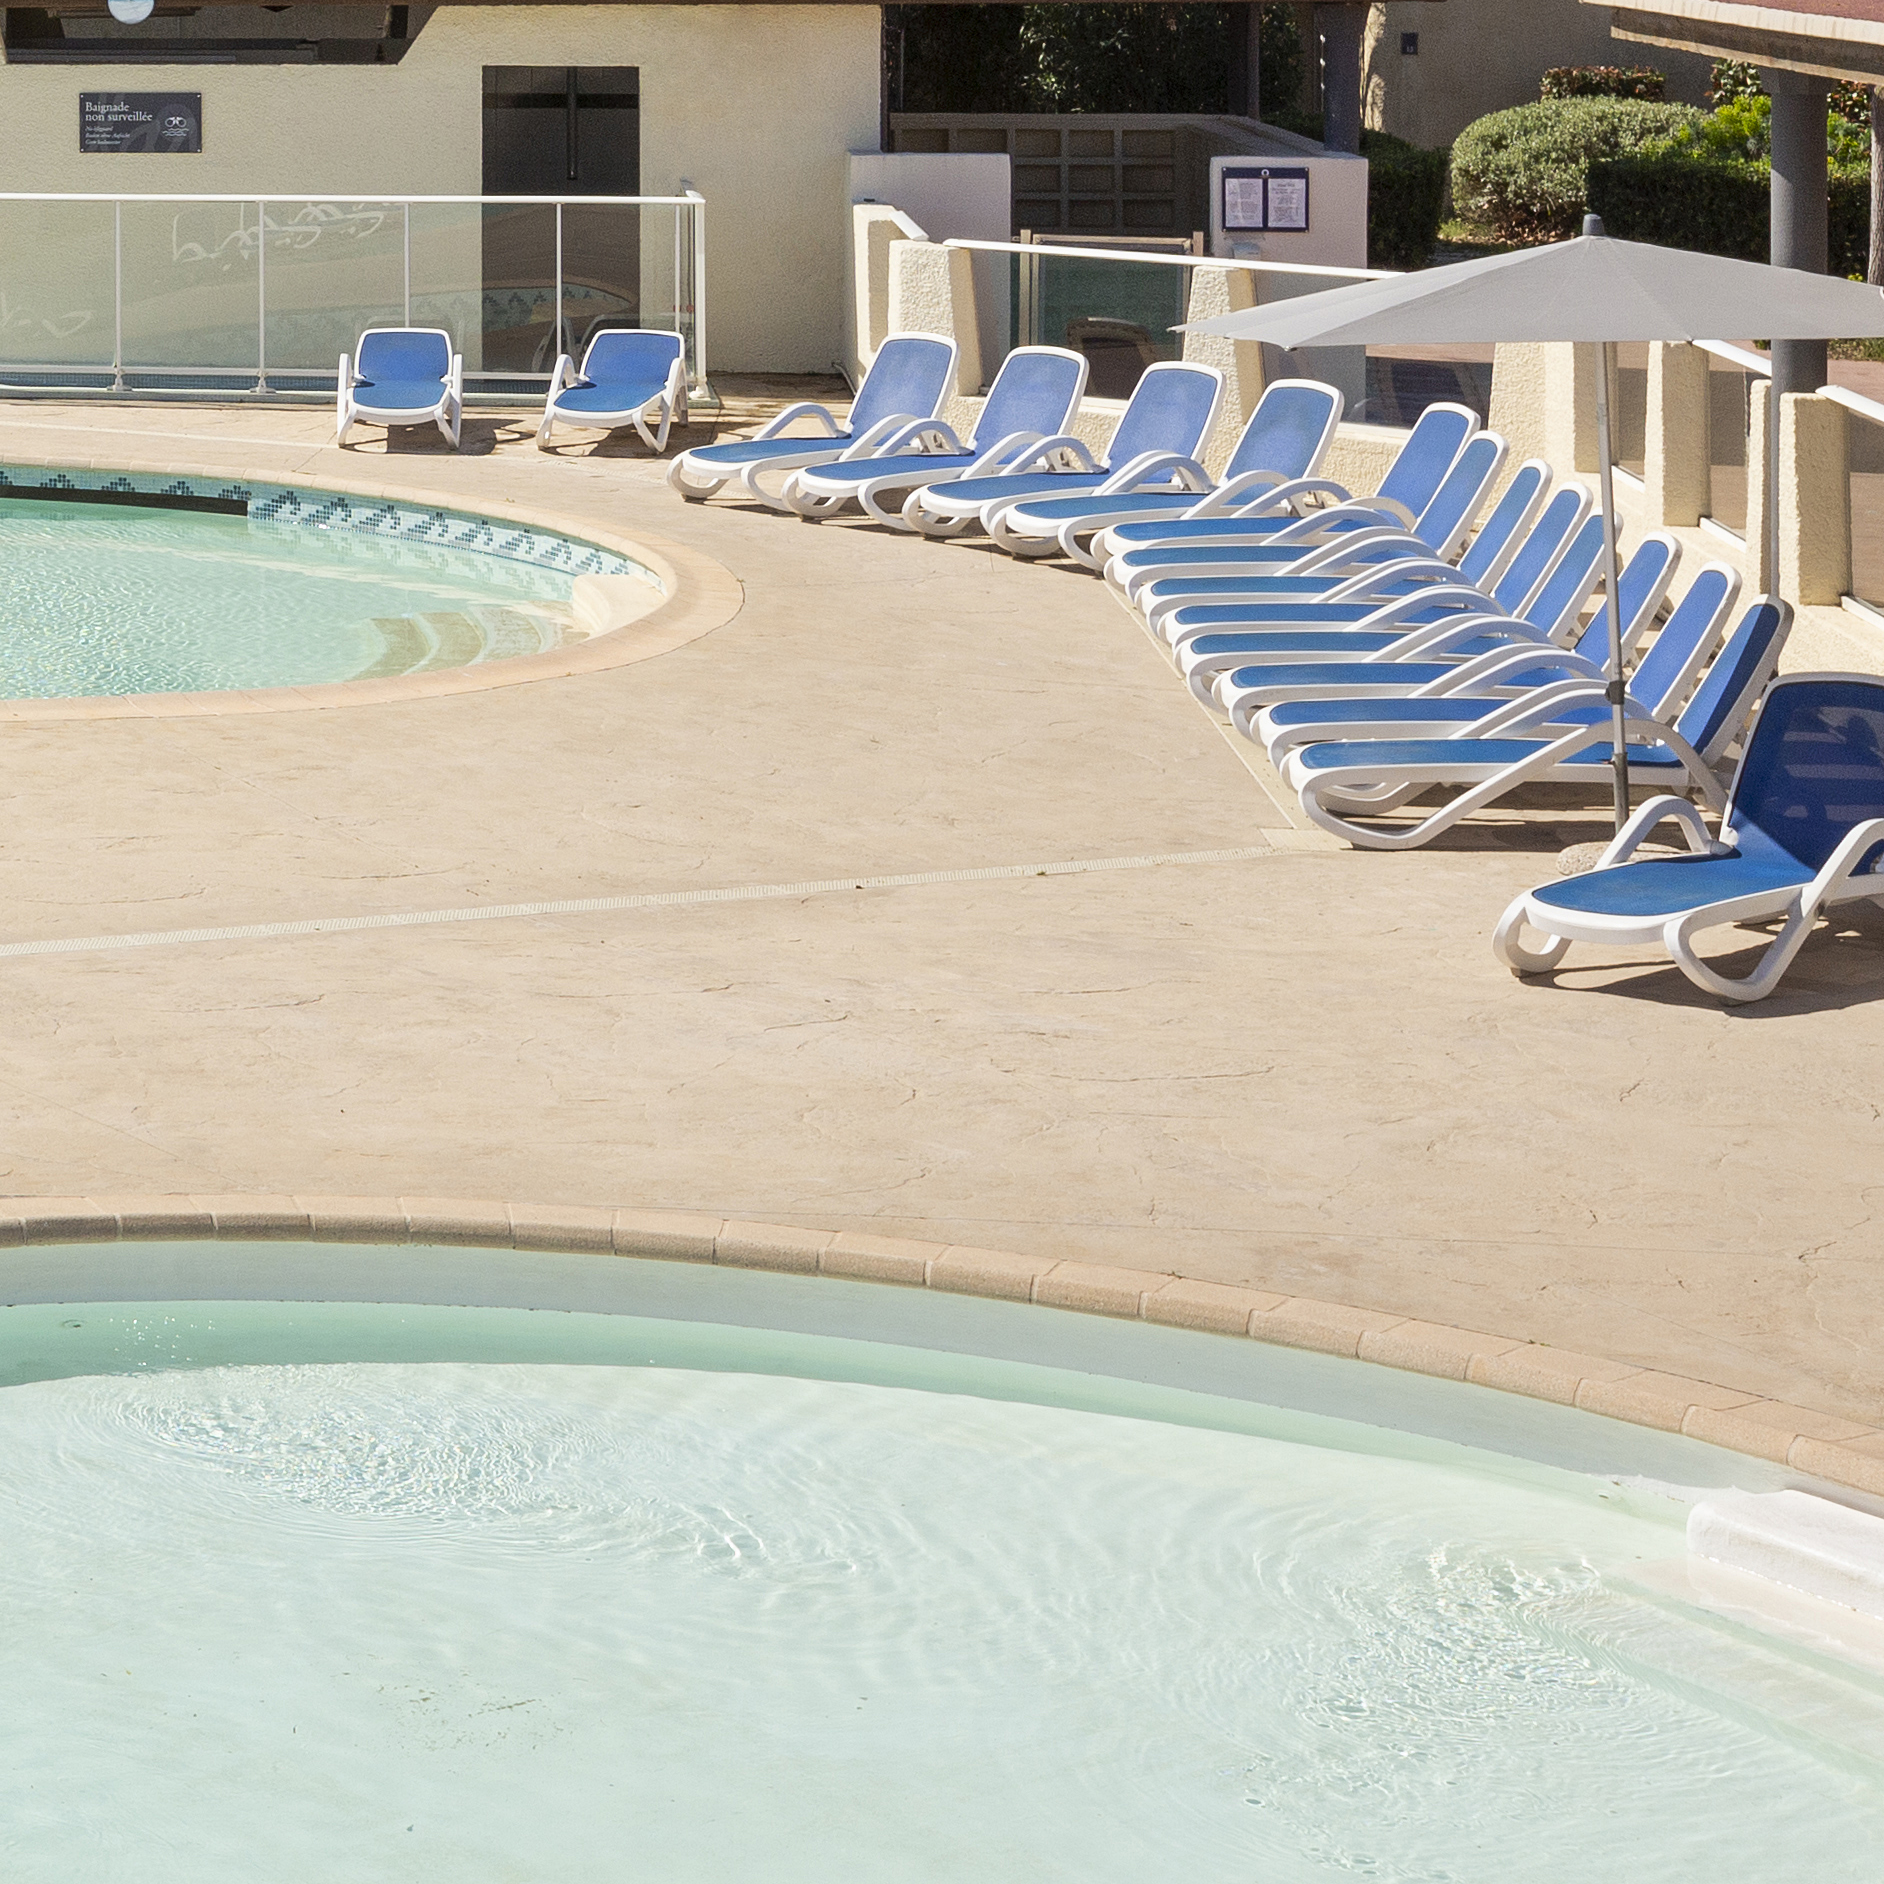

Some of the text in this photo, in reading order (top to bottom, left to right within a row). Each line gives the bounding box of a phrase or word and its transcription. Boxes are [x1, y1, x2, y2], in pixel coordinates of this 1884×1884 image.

[85, 101, 130, 114] Baignade
[85, 111, 153, 122] non surveillée
